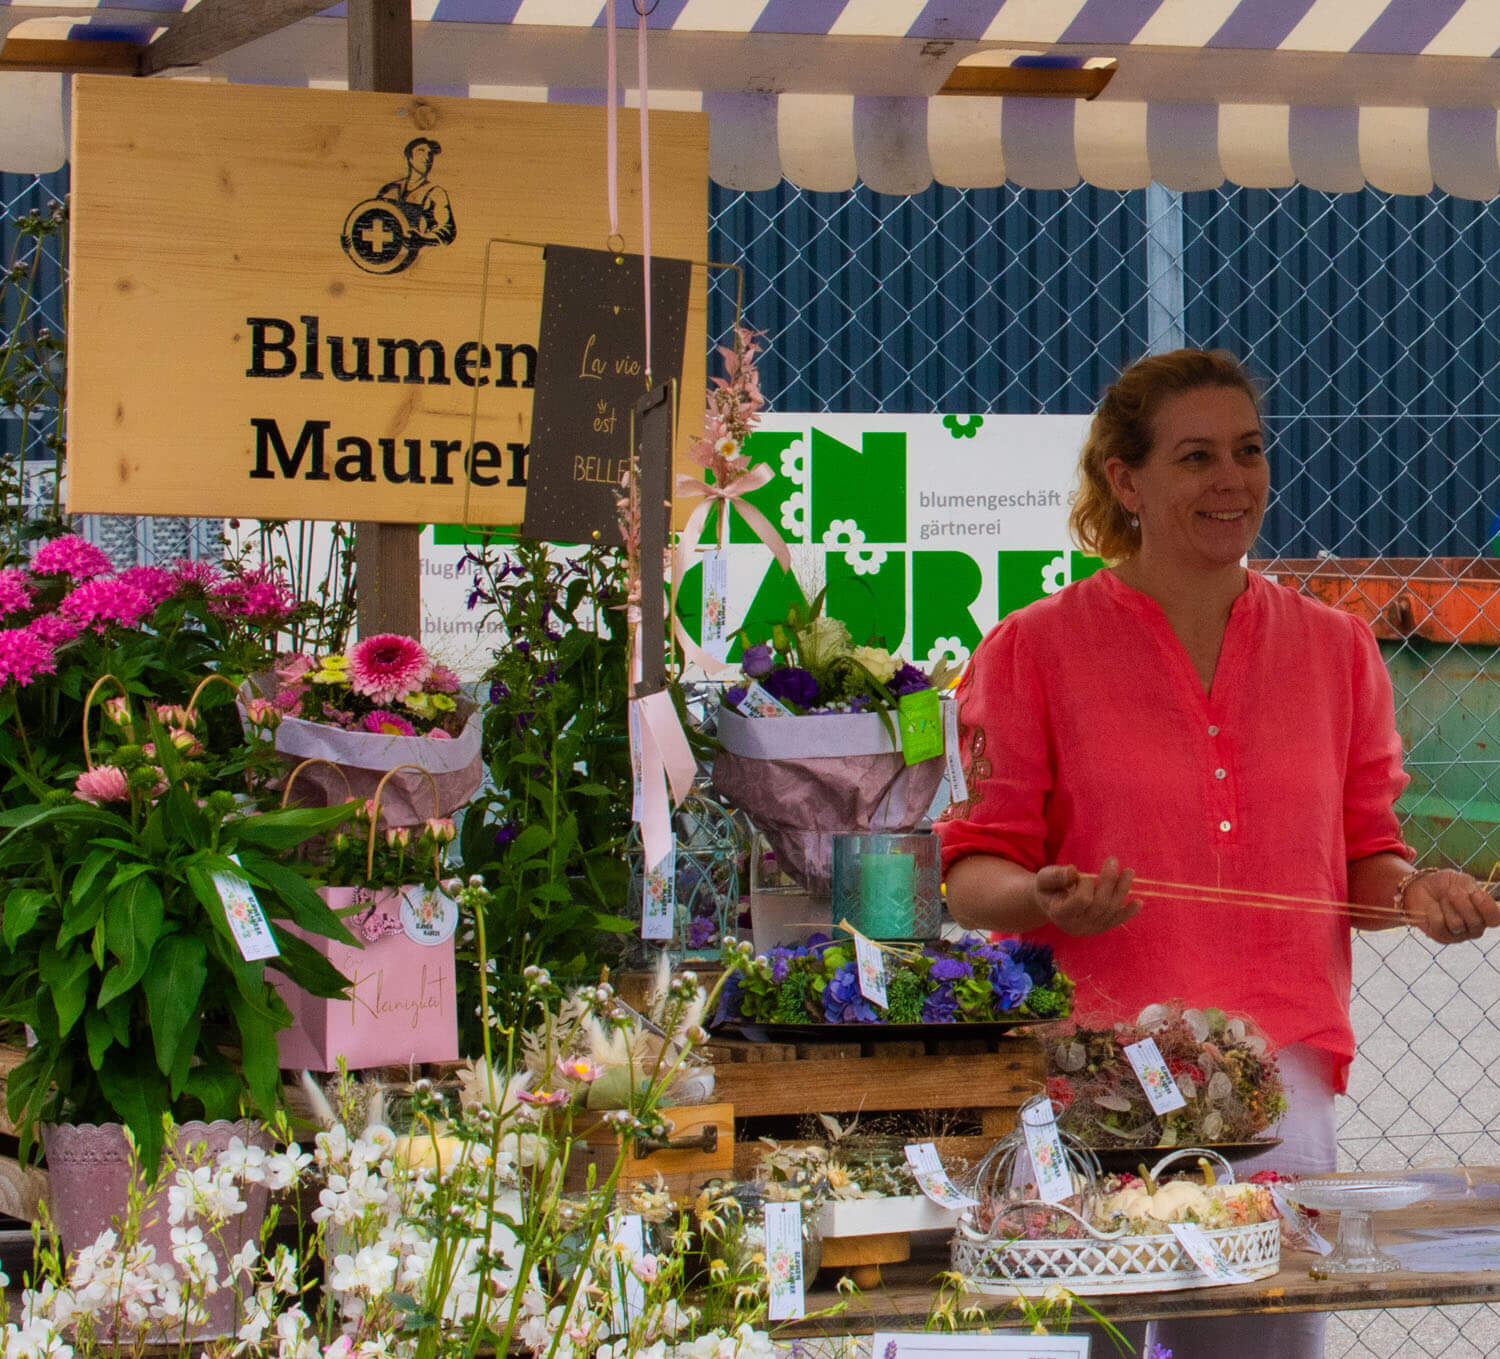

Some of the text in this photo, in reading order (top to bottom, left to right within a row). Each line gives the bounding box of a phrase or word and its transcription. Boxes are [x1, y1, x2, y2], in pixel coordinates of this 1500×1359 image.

[246, 315, 538, 388] Blumen
[578, 333, 641, 379] La vie
[592, 407, 617, 434] est
[249, 418, 530, 487] Maurer
[573, 455, 632, 485] BELLE
[919, 489, 1062, 512] blumengeschäft
[919, 519, 1001, 541] gärtnerei
